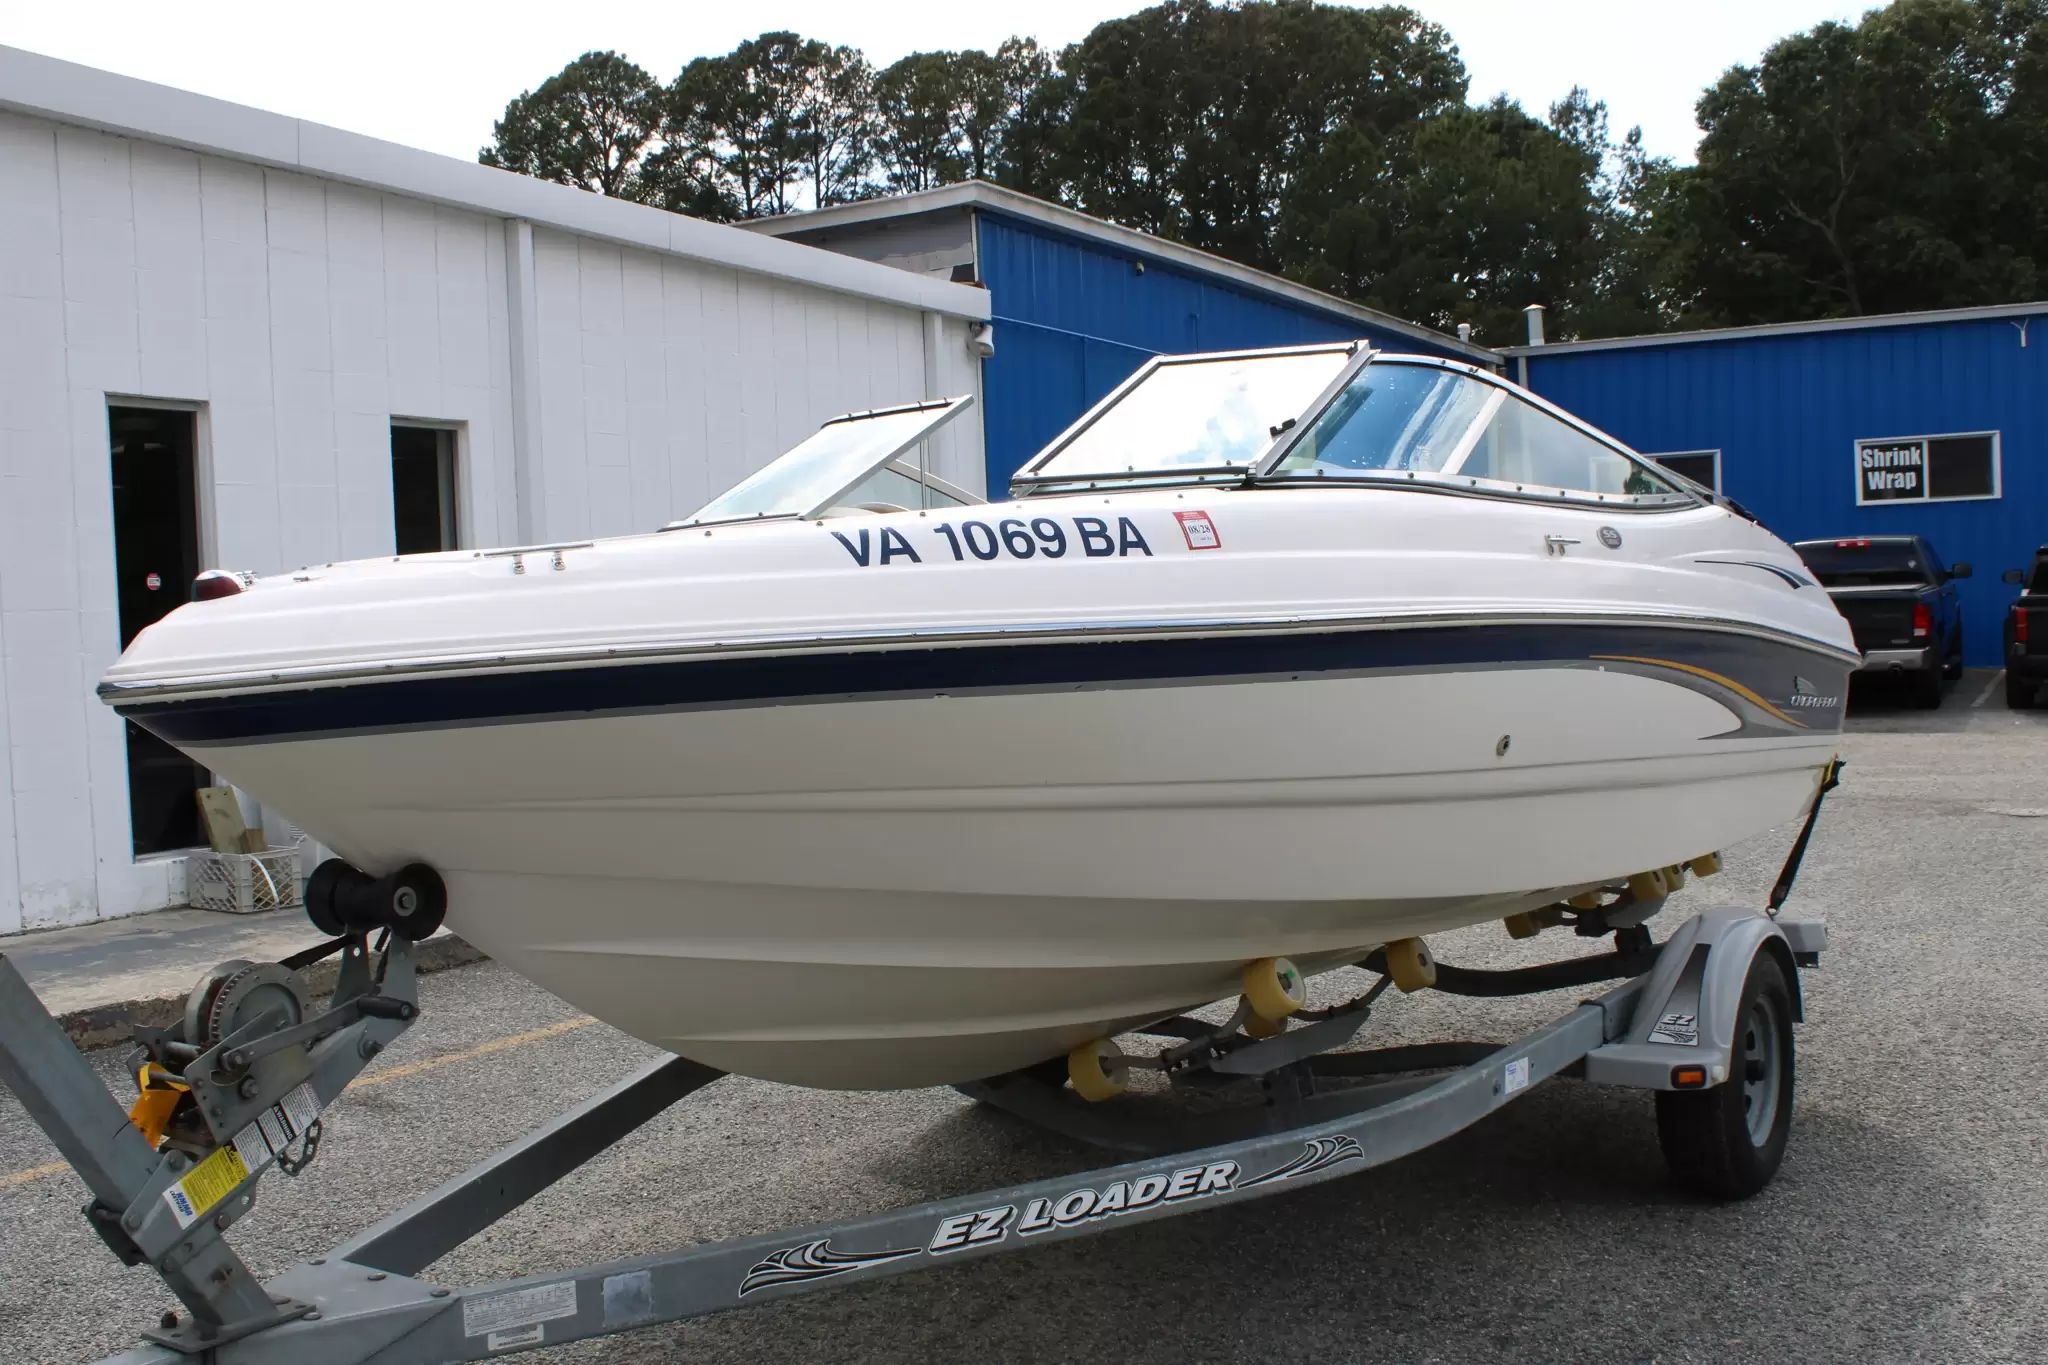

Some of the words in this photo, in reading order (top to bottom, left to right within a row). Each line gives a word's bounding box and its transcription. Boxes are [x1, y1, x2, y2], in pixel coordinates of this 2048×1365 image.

[1862, 446, 1922, 469] Shrink
[1867, 470, 1917, 491] Wrap
[830, 526, 922, 568] VA
[933, 517, 1067, 562] 1069
[1072, 516, 1154, 558] BA
[276, 1110, 295, 1141] WARNING
[928, 1205, 1017, 1256] EZ
[1016, 1159, 1242, 1236] LOADER
